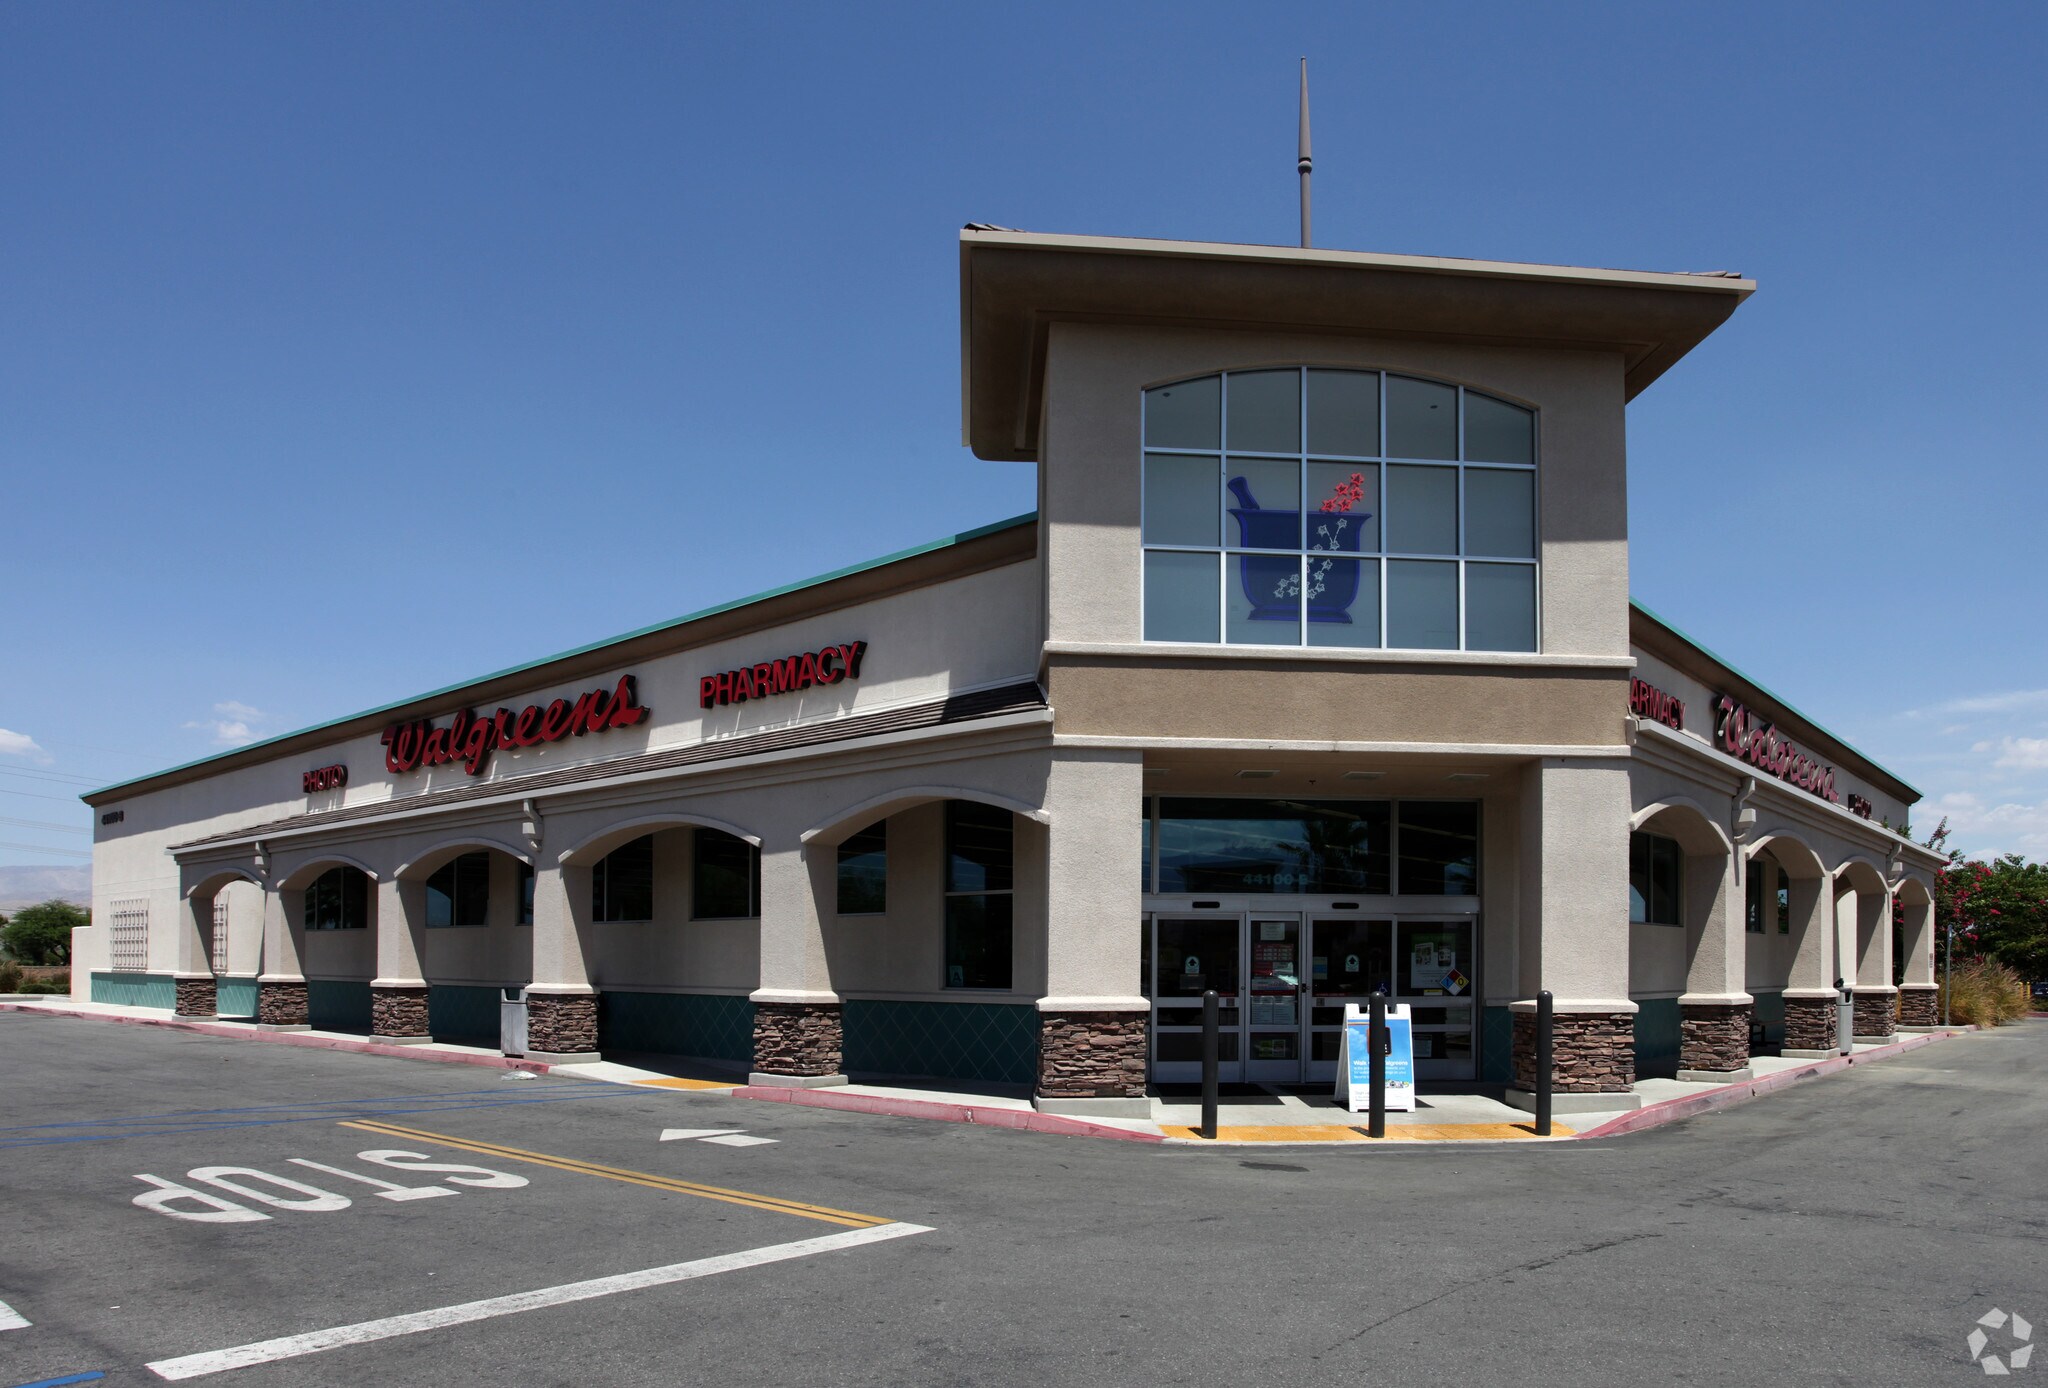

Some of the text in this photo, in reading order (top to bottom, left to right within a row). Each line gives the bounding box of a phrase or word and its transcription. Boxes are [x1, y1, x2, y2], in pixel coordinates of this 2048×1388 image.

[700, 640, 867, 709] PHARMACY
[1630, 676, 1686, 730] ARMACY
[381, 674, 648, 776] Walgreens
[1713, 694, 1839, 803] Walgreens
[303, 764, 348, 793] PHOTO
[132, 1149, 530, 1223] STOP
